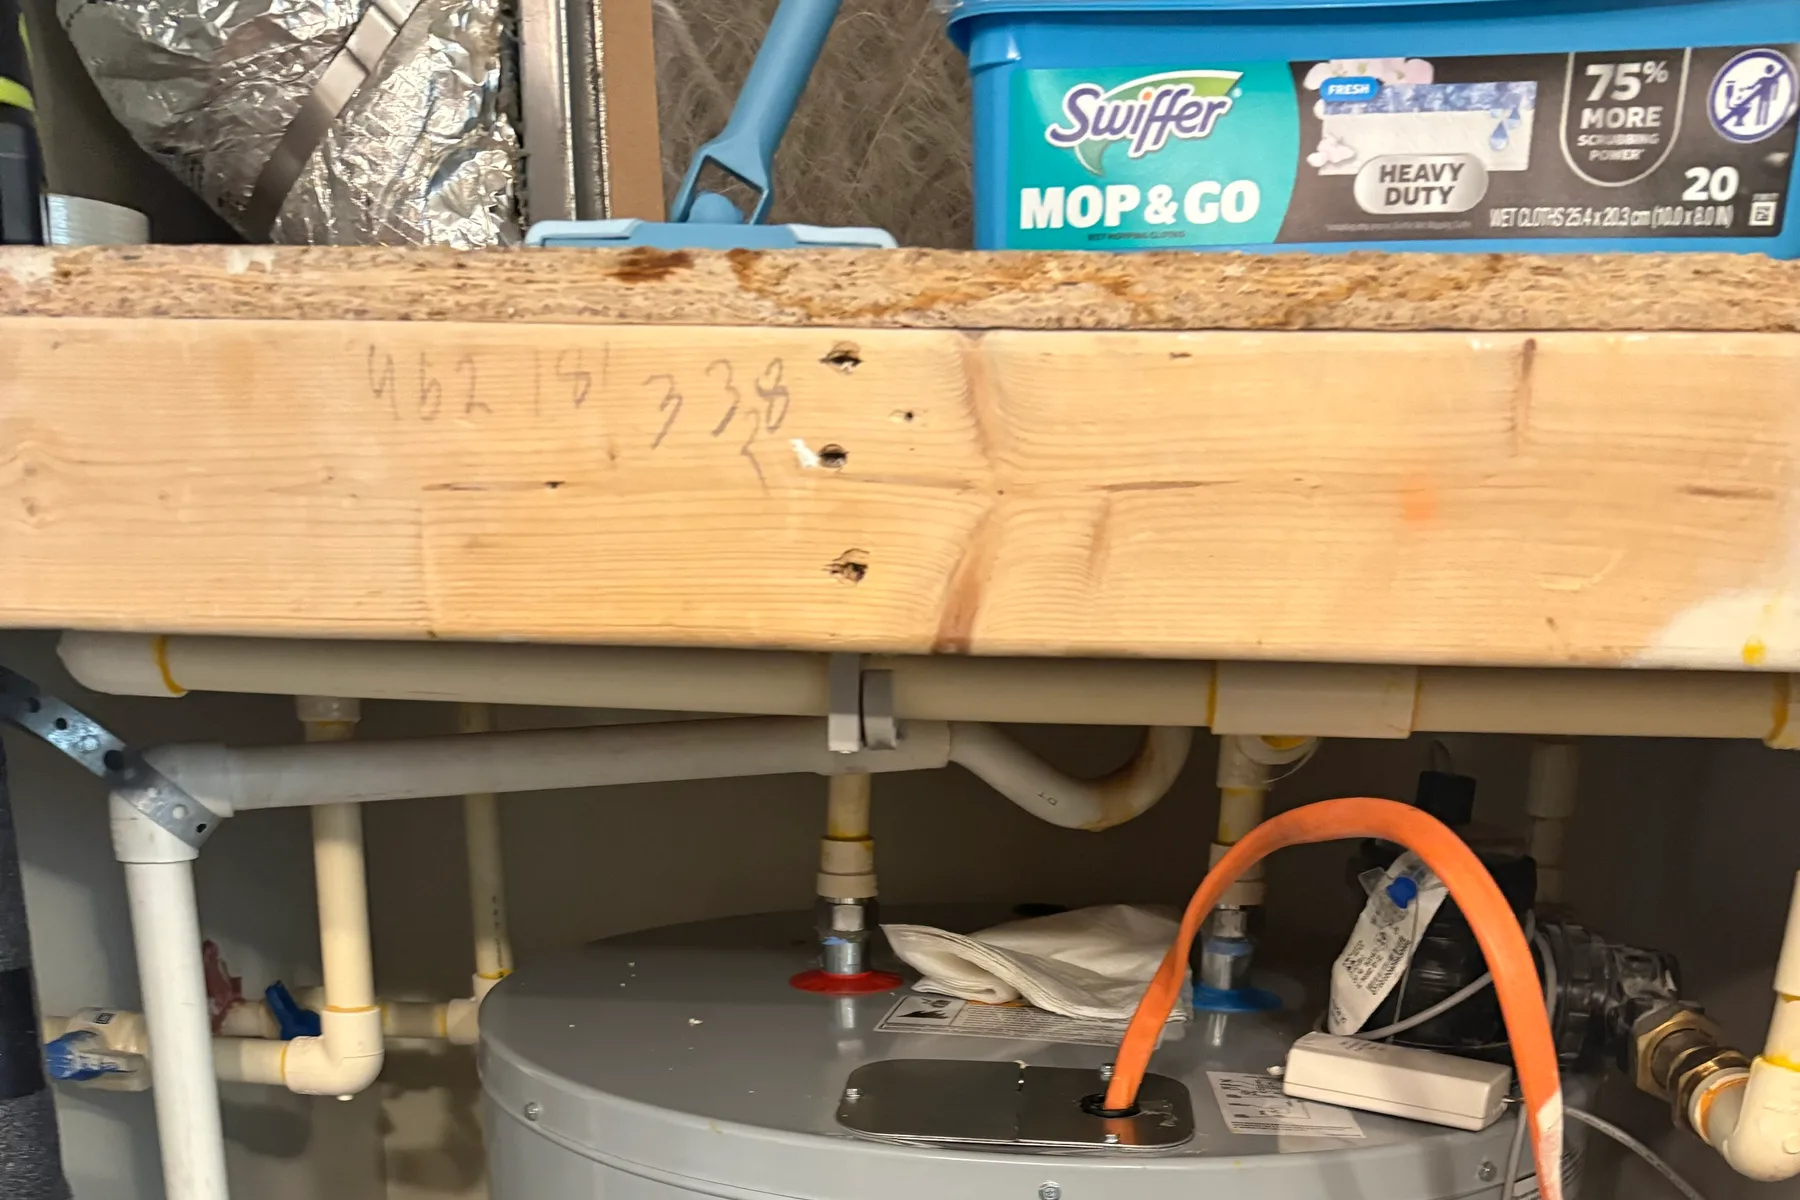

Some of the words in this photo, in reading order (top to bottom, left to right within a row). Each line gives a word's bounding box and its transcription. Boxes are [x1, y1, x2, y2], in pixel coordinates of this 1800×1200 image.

[1328, 84, 1370, 95] FRESH
[1585, 61, 1669, 101] 75%
[1048, 86, 1230, 155] Swiffer
[1580, 106, 1663, 129] MORE
[1379, 163, 1465, 184] HEAVY
[1682, 166, 1739, 201] 20
[1020, 184, 1140, 229] MOP
[1184, 180, 1260, 224] GO
[1384, 186, 1456, 206] DUTY
